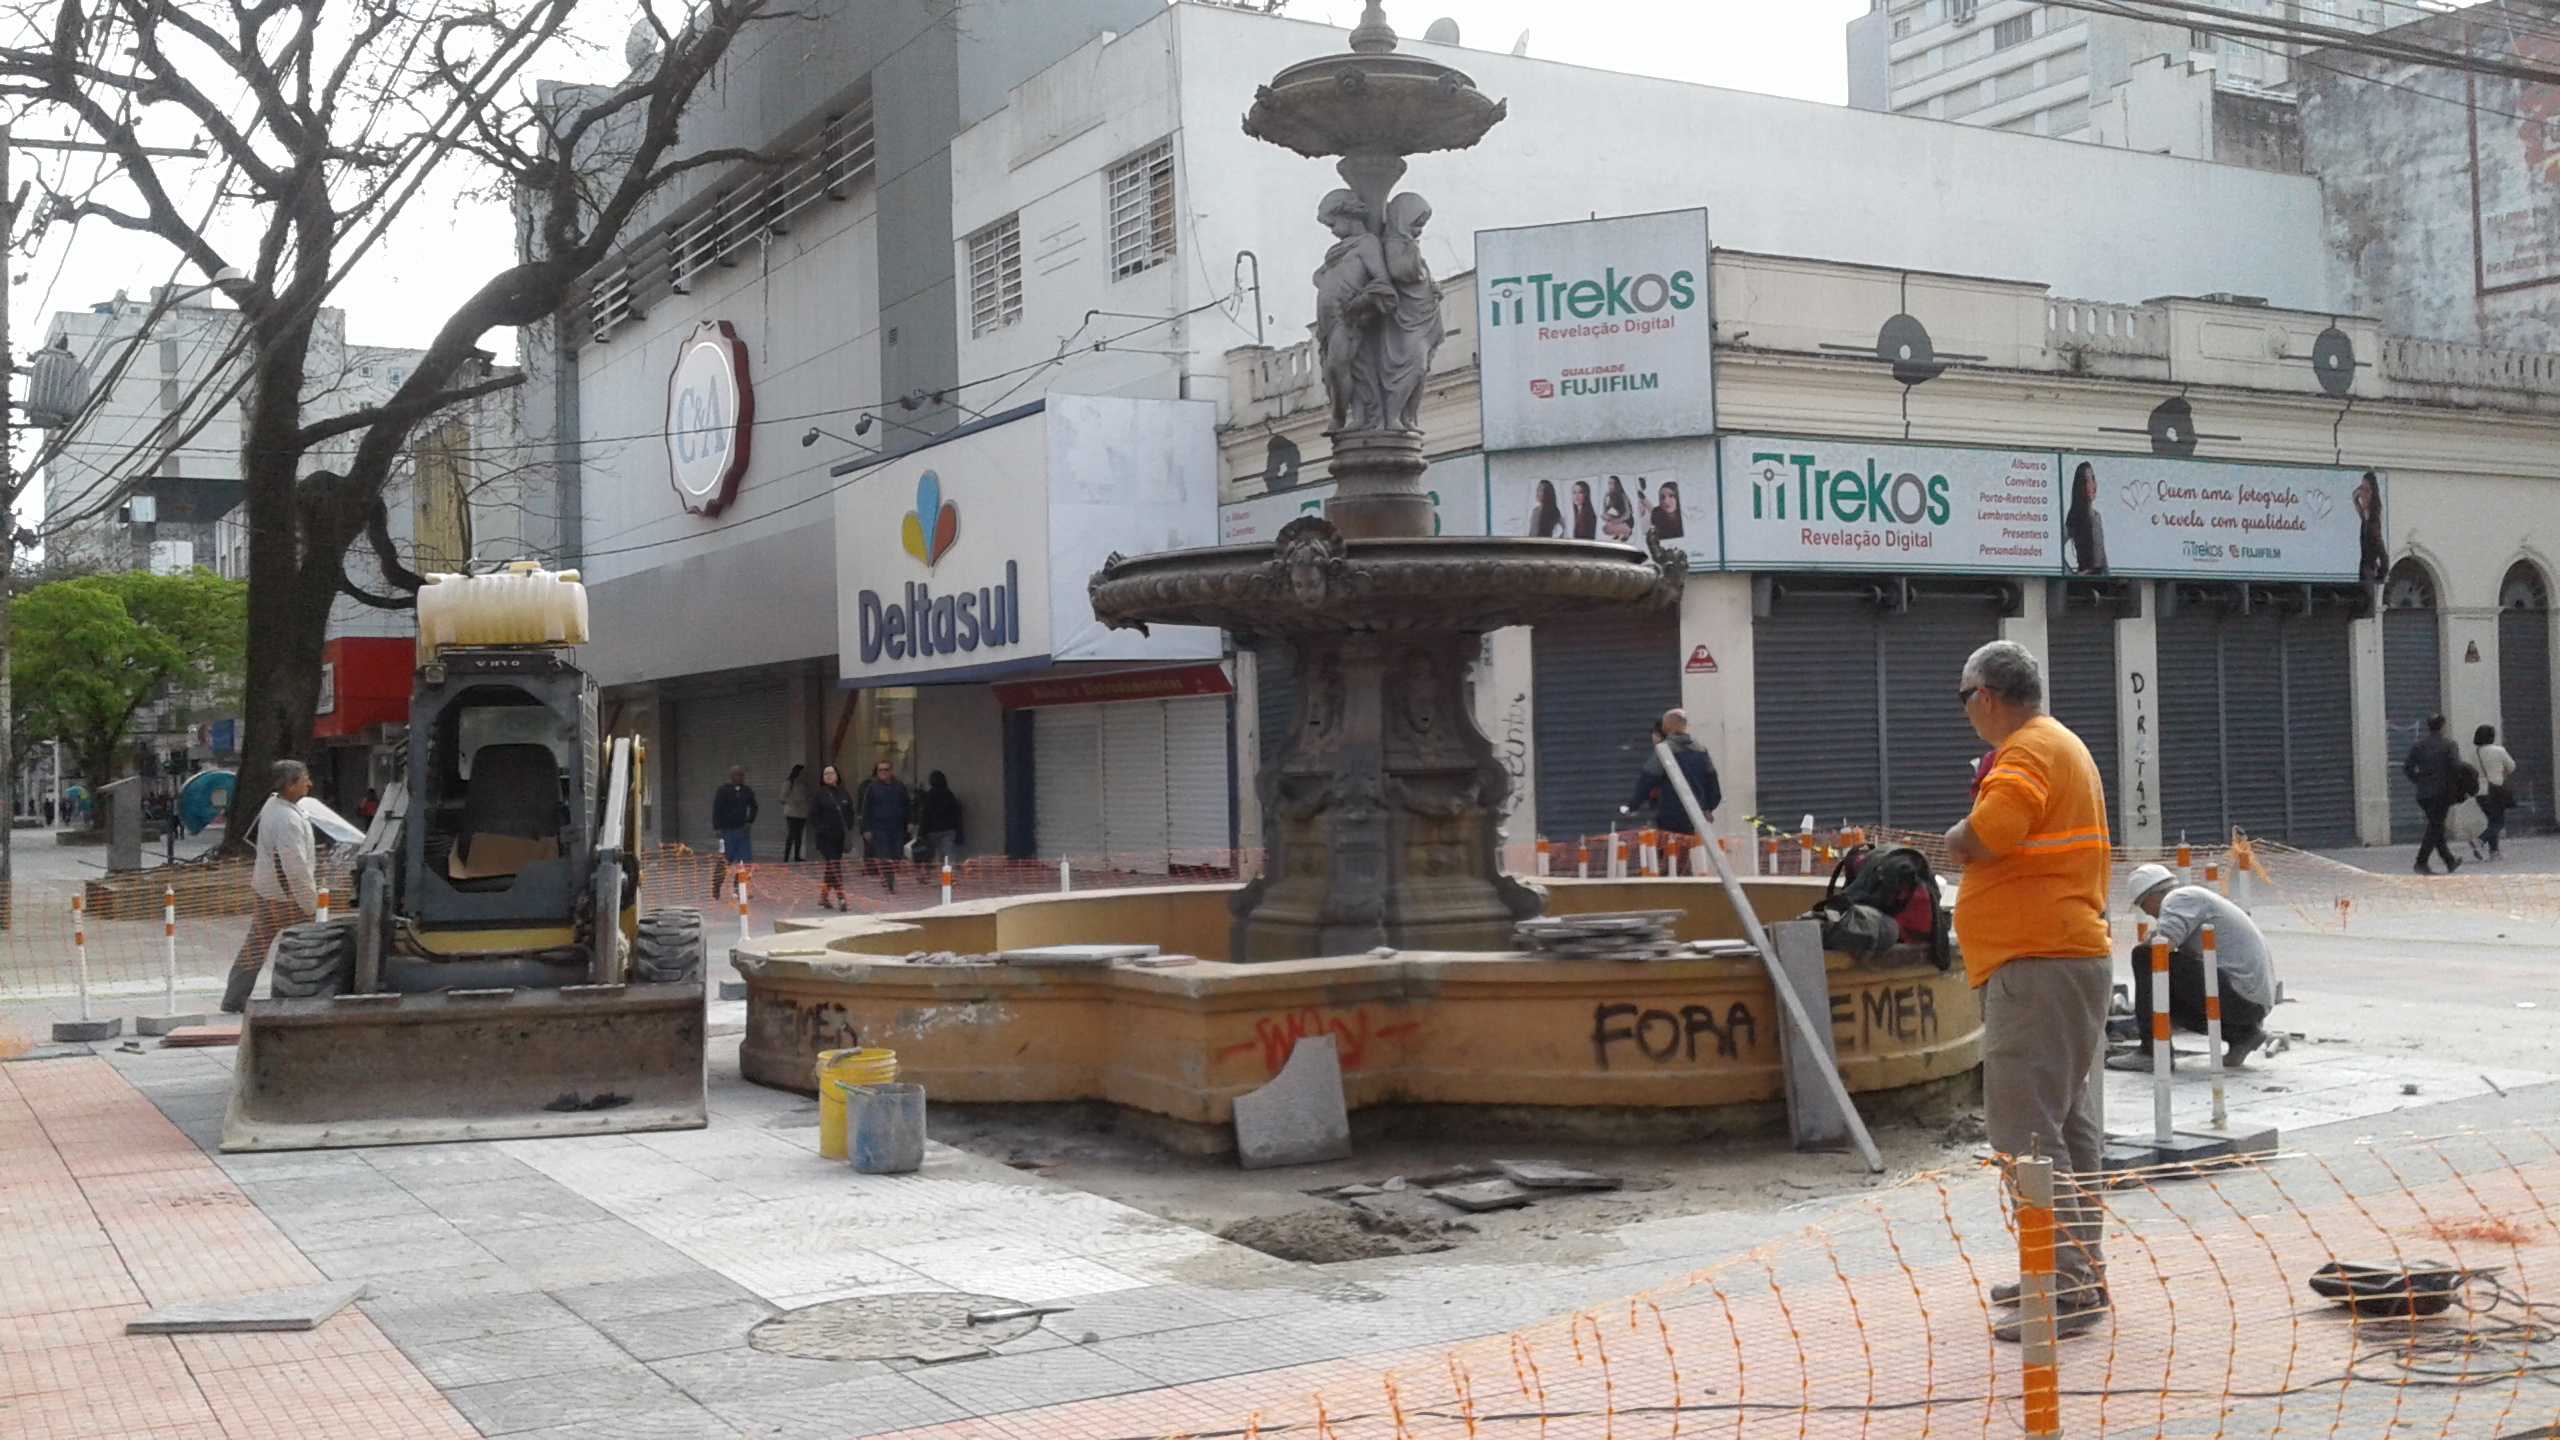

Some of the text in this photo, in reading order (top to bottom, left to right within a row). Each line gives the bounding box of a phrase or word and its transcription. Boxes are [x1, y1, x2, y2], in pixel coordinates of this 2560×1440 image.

[1527, 267, 1695, 322] Trekos
[1539, 315, 1675, 341] Revelação Digital
[1561, 364, 1625, 377] QUALIDADE
[1561, 372, 1659, 396] FUJIFILM
[677, 375, 726, 464] C&A
[1789, 455, 1950, 525] Trekos
[2005, 475, 2040, 488] Convites
[2157, 479, 2300, 509] Quem ama fotografa
[1978, 510, 2042, 522] Lembrancinhas
[2151, 509, 2307, 534] e revela com qualidade
[1801, 528, 1933, 551] Revelação Digital
[2002, 527, 2042, 539] Presentes
[1980, 543, 2042, 557] Personalizados
[859, 559, 1019, 664] Deltasul
[1593, 983, 1939, 1071] FORA EMER
